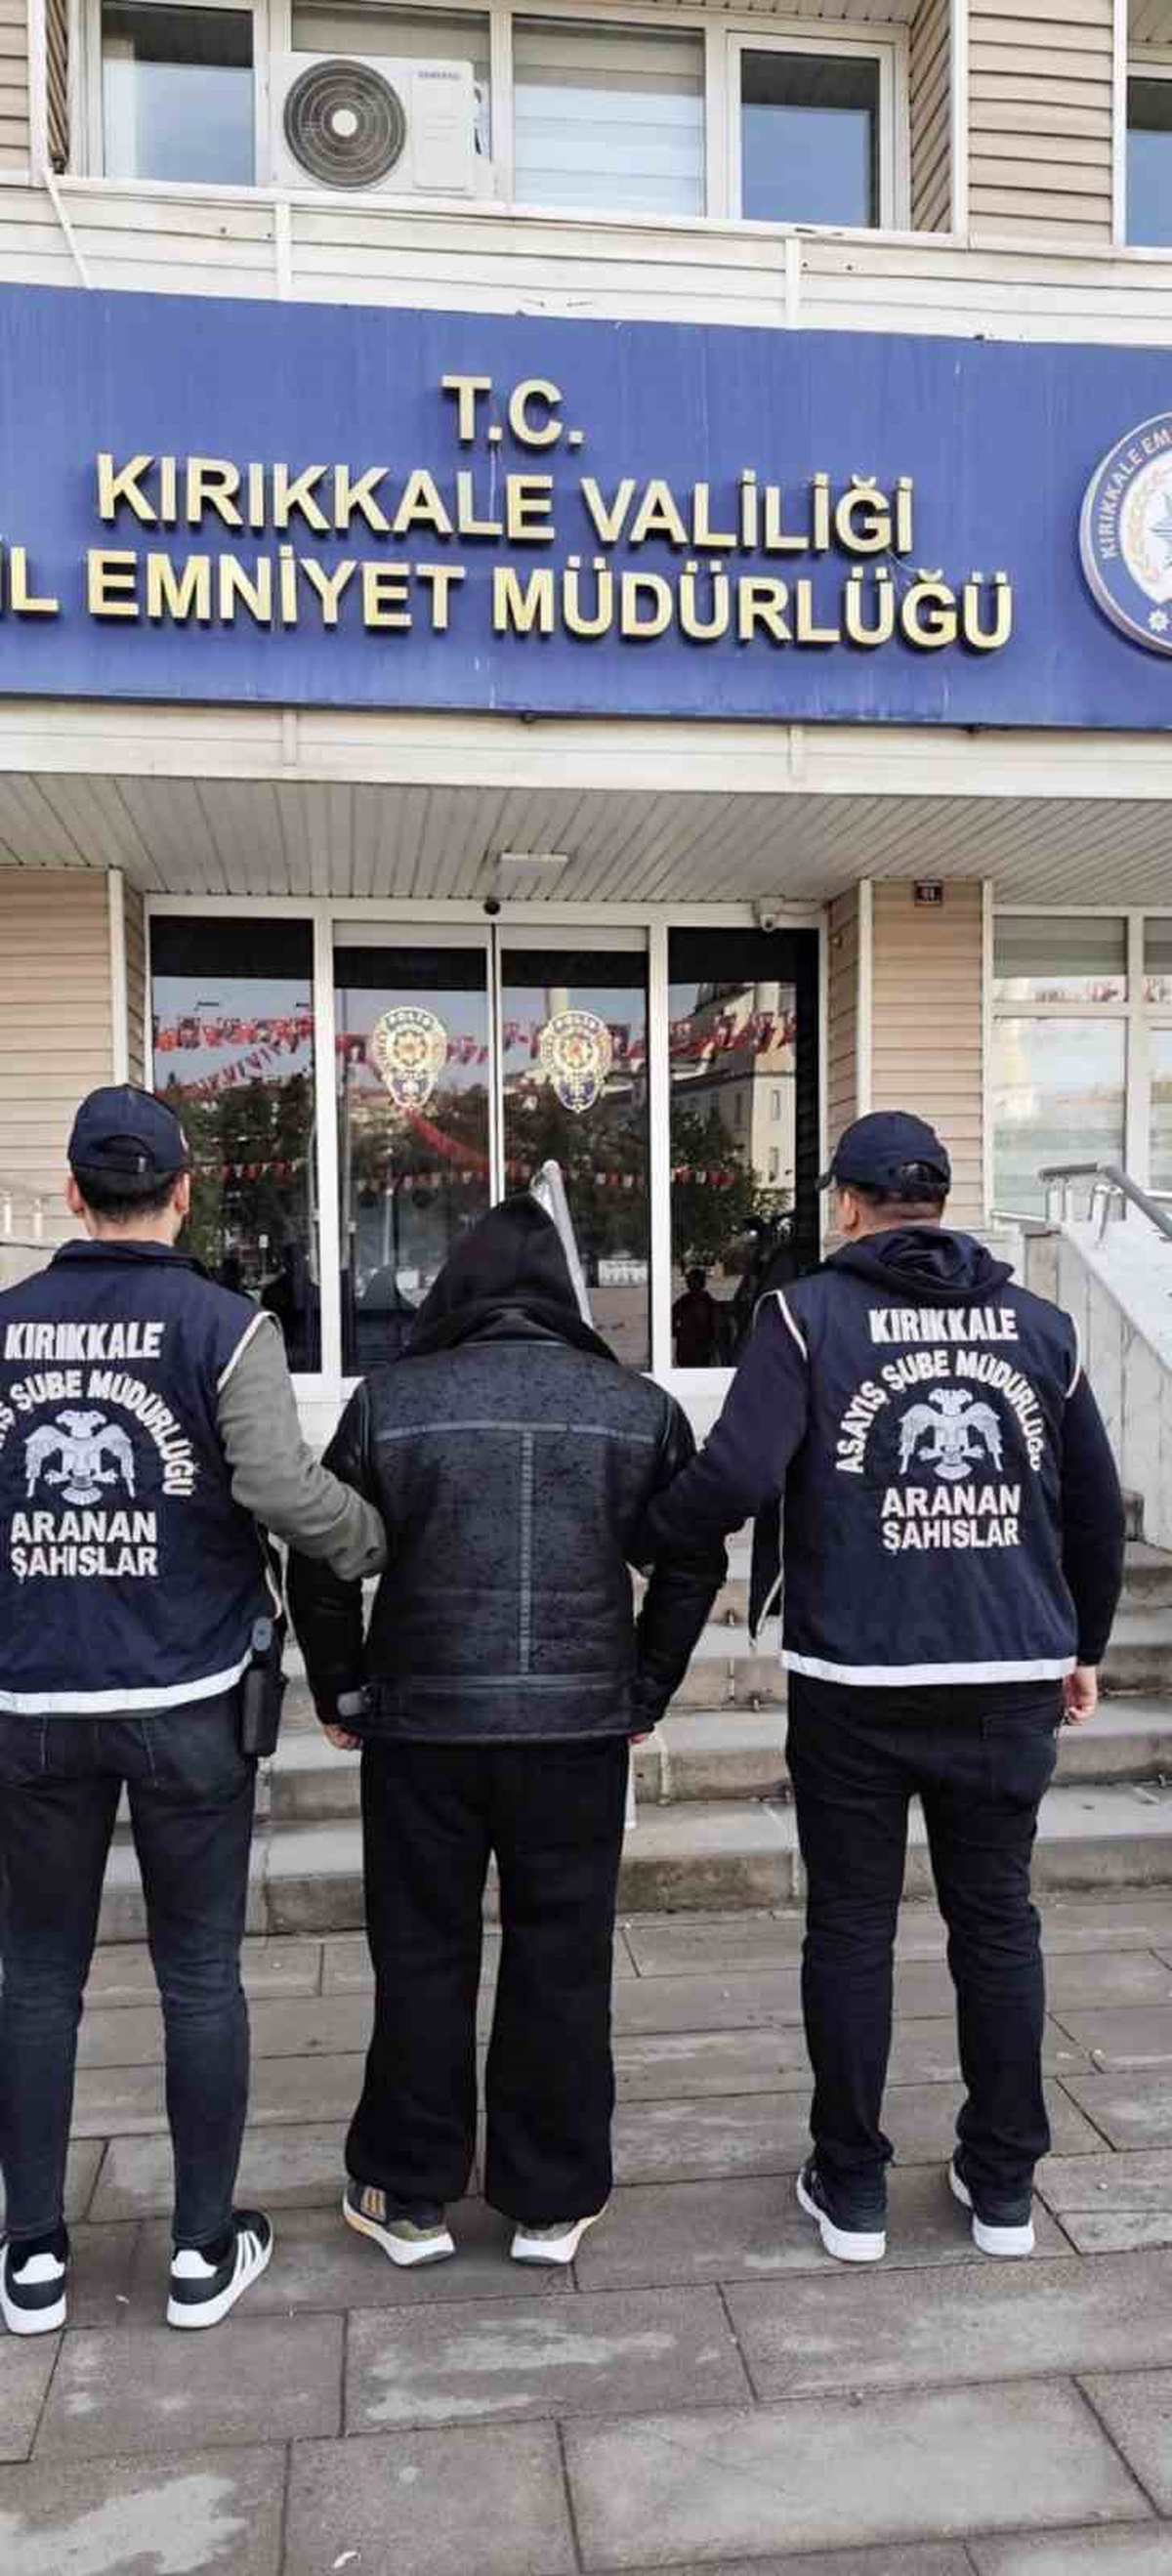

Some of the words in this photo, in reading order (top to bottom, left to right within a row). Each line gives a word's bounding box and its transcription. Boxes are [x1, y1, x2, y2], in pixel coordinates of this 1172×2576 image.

[441, 375, 584, 445] T.C.
[98, 453, 555, 540] KIRIKKALE
[580, 468, 913, 553] VALİLİĞİ
[1098, 447, 1143, 561] KIRIKKALE
[0, 543, 59, 612] L
[88, 544, 465, 630] EMNİYET
[494, 556, 1013, 650] MÜDÜRLÜĞÜ
[4, 1322, 165, 1360] KIRIKKALE
[868, 1307, 1019, 1342] KIRIKKALE
[881, 1485, 1022, 1518] ARANAN
[10, 1510, 157, 1543] ARANAN
[882, 1517, 1022, 1555] ŞAHISLAR
[11, 1544, 159, 1584] ŞAHISLAR
